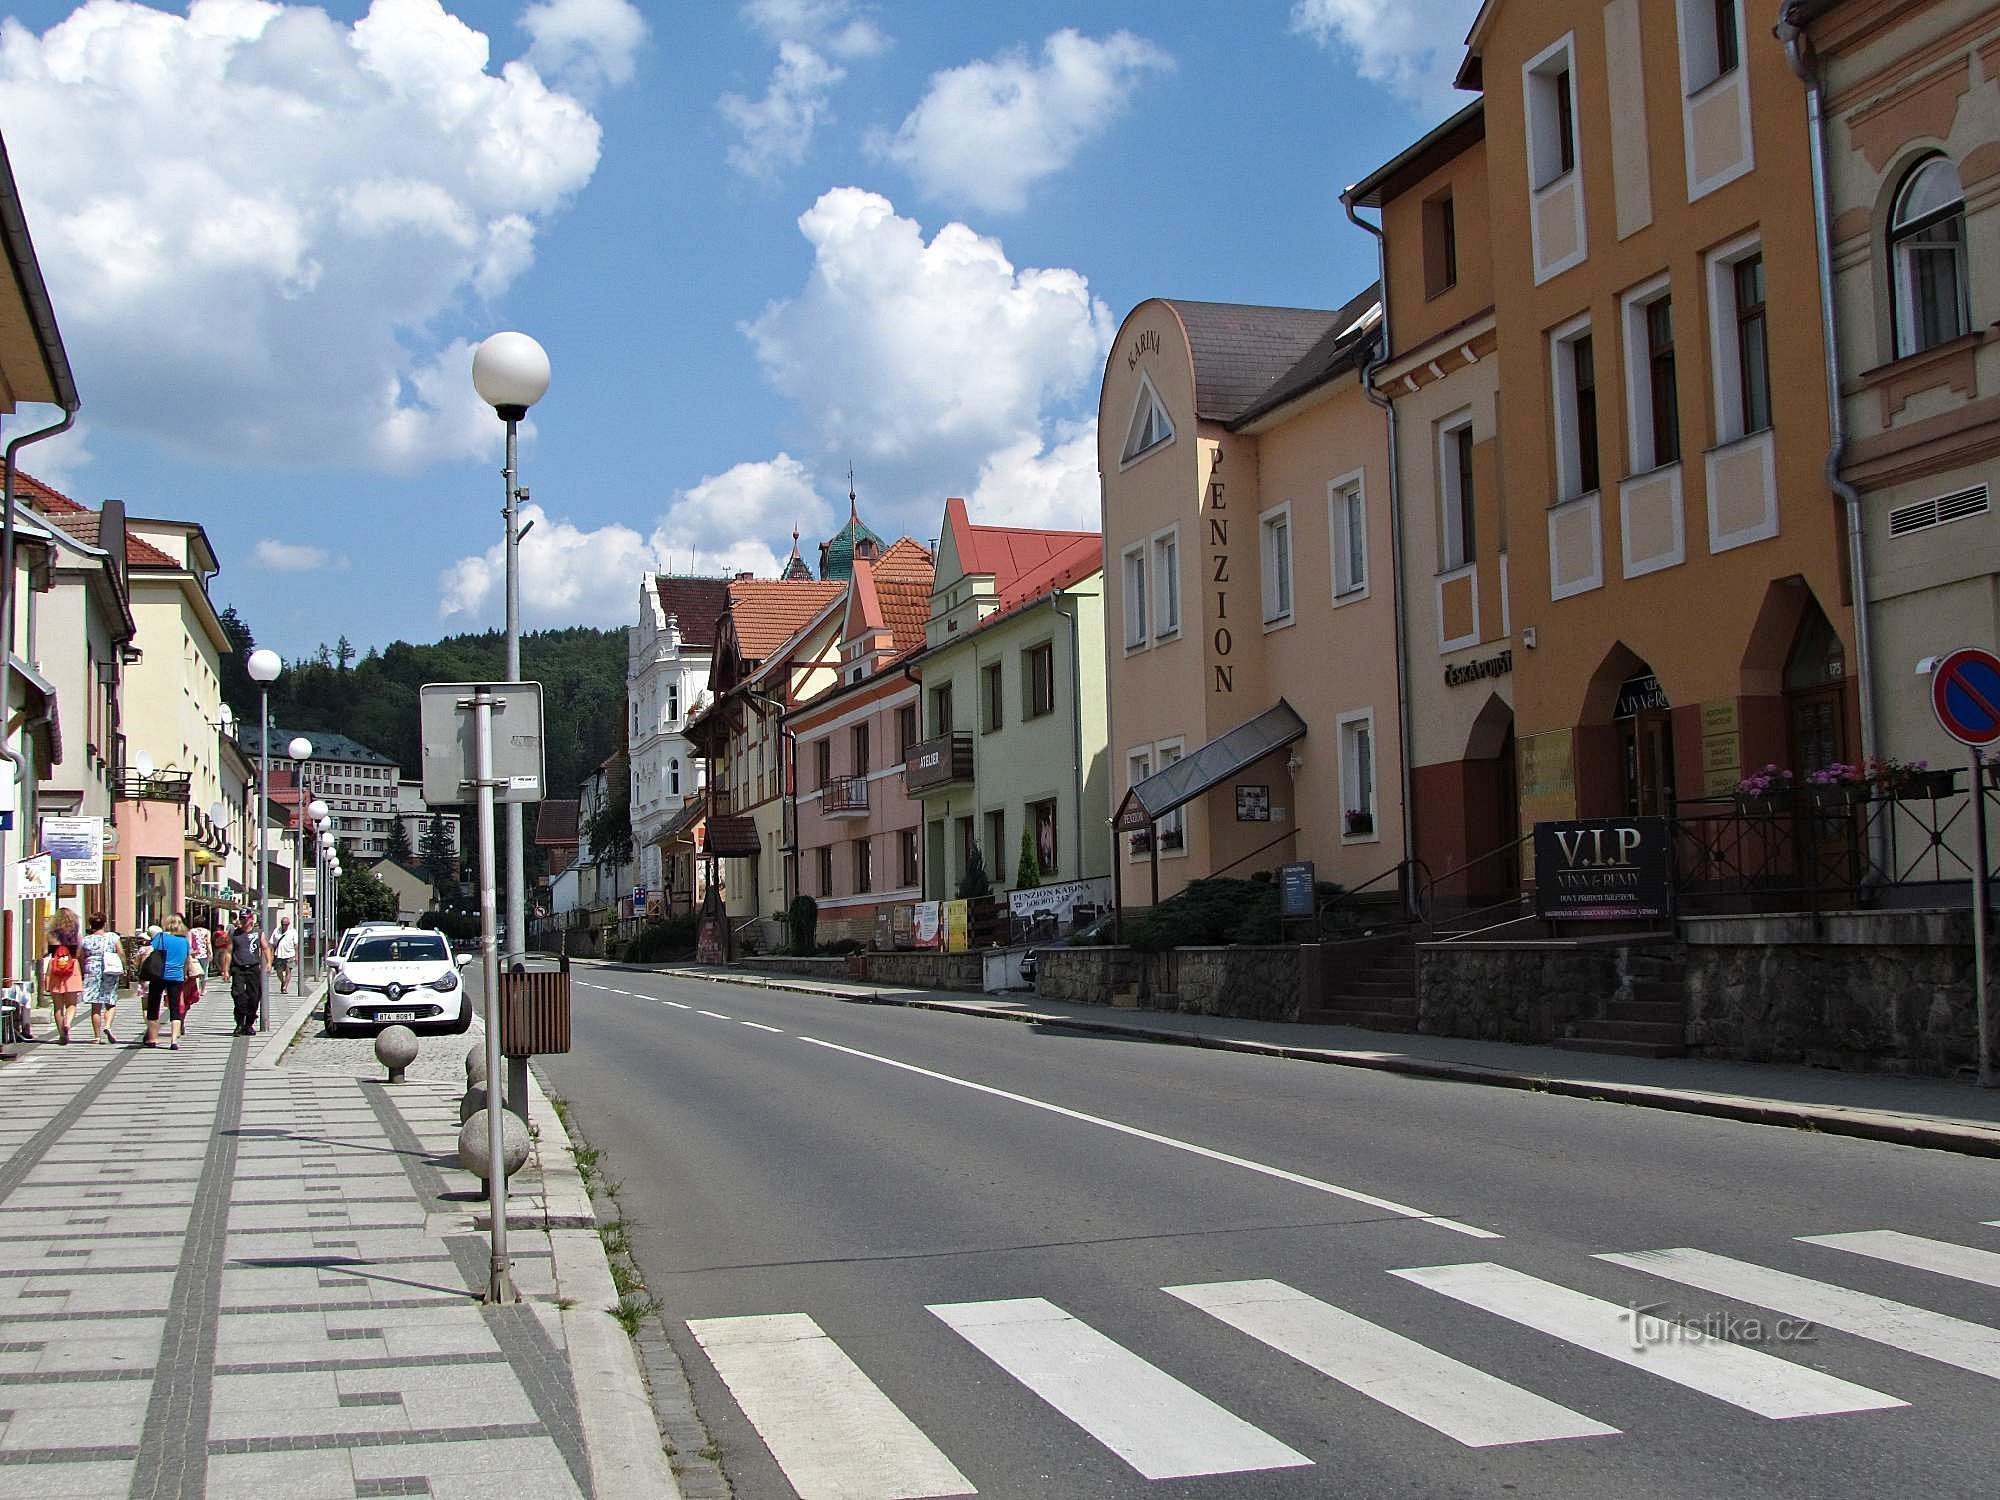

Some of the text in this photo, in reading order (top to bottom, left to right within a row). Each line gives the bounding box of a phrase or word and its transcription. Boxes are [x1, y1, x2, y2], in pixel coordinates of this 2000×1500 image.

[1128, 330, 1160, 371] KARINA
[1209, 448, 1233, 692] PENZION
[920, 751, 939, 768] ATELIER
[1554, 828, 1641, 867] V.I.P
[1013, 883, 1091, 902] PENZION KARINA
